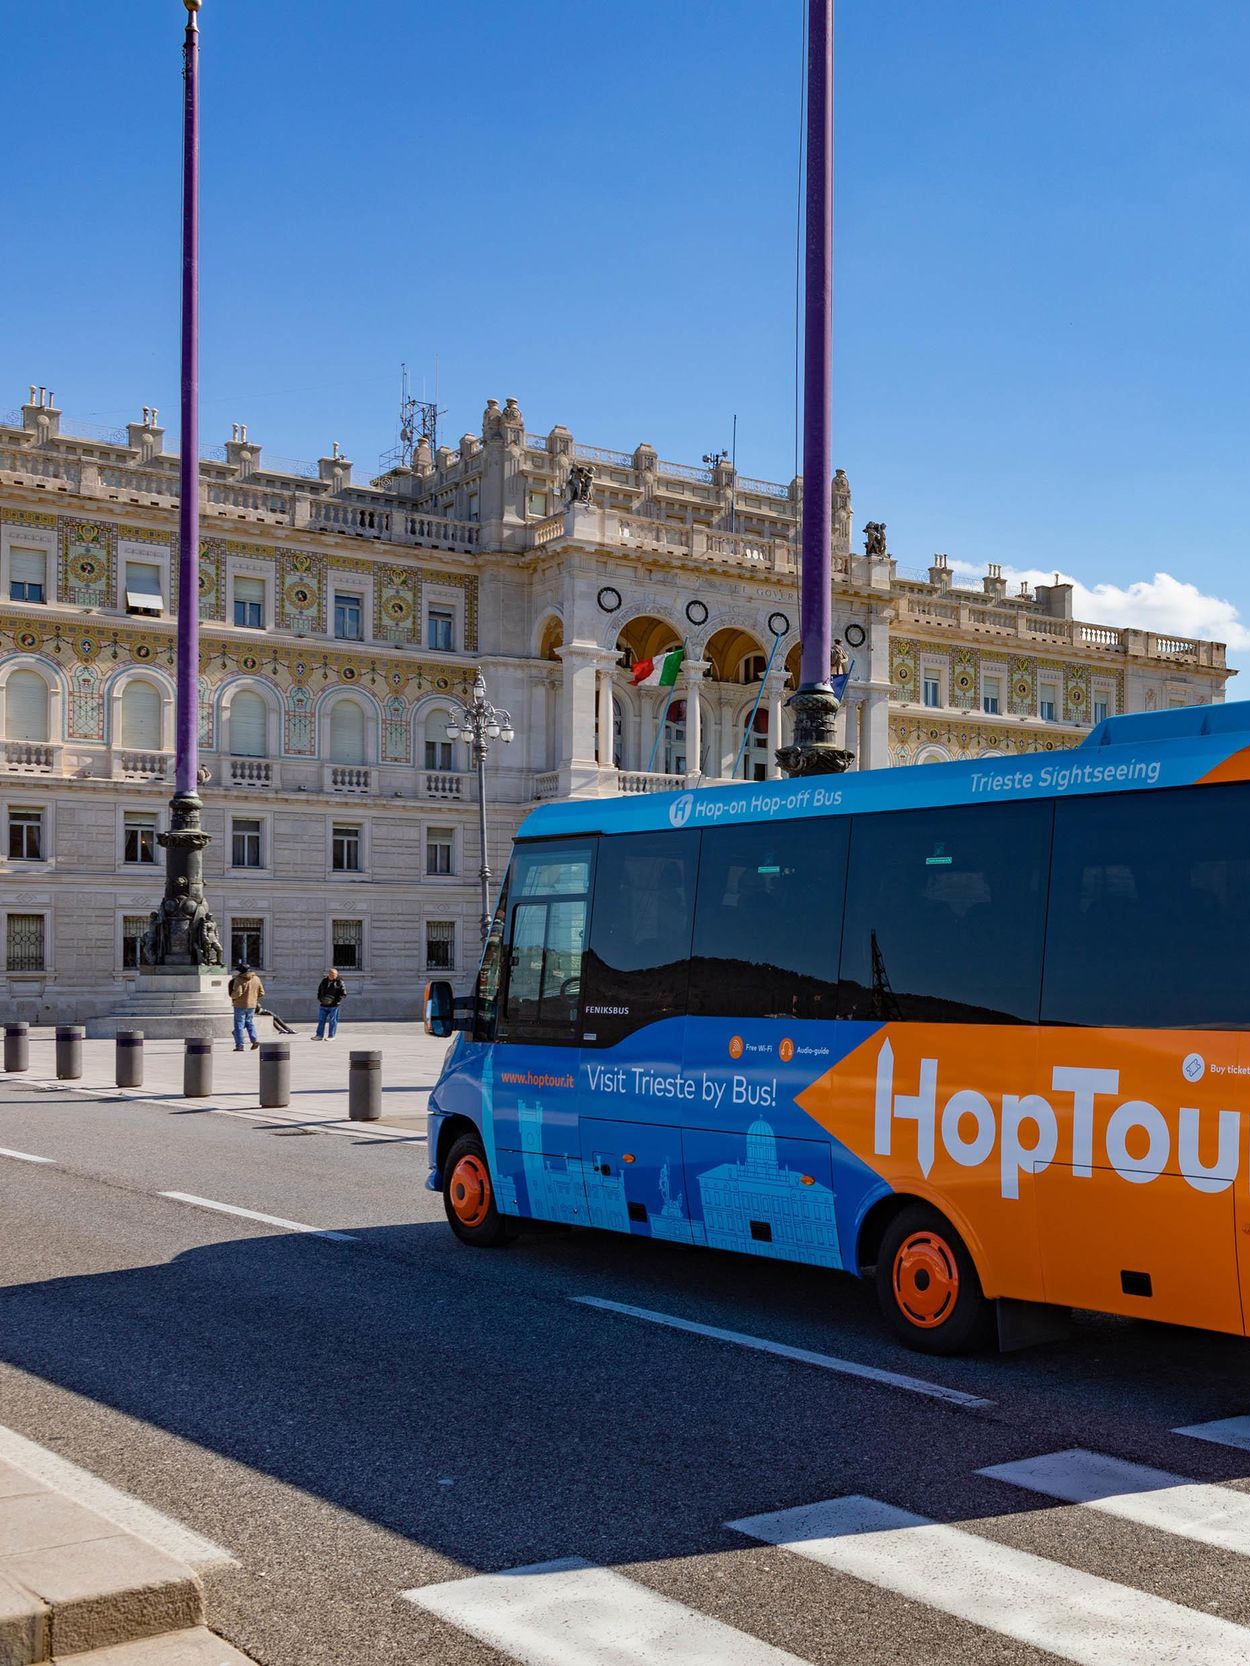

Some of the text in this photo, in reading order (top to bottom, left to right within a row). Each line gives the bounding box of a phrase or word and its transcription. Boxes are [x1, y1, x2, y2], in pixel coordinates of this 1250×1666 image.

[970, 759, 1161, 793] Trieste Sightseeing
[695, 800, 747, 820] Hop-on
[750, 789, 812, 815] Hop-off
[813, 788, 843, 807] Bus
[585, 1006, 630, 1015] FENIKSBUS
[745, 1043, 773, 1053] Free Wi-Fi
[796, 1046, 830, 1057] Audio-guide
[1210, 1063, 1226, 1075] Buy
[501, 1071, 574, 1089] www.hoptour.it
[587, 1064, 777, 1108] Visit Trieste by Bus!
